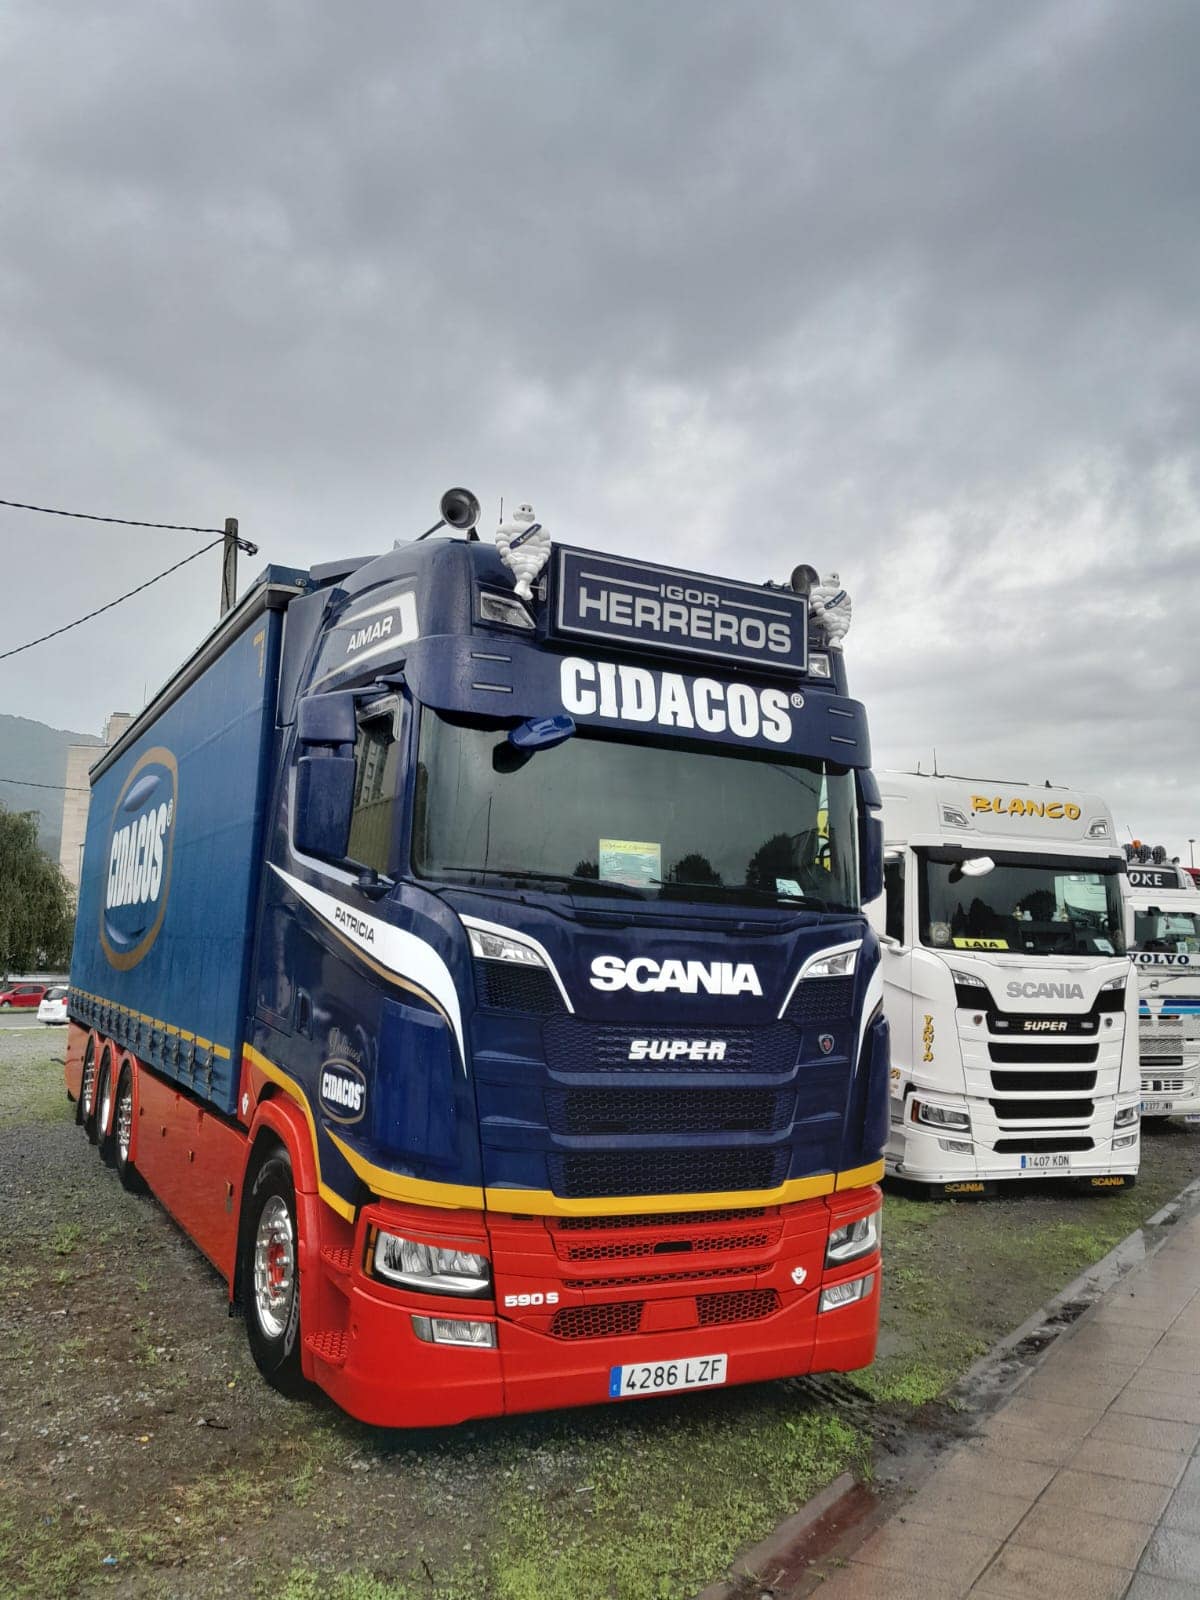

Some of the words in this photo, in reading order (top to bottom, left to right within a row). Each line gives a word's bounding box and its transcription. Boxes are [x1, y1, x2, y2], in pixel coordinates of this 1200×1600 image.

[660, 584, 720, 608] IGOR
[579, 587, 791, 653] HERREROS
[346, 616, 393, 653] AIMAR
[970, 795, 1081, 820] BLANCO
[335, 906, 374, 944] PATRICIA
[1127, 953, 1190, 965] VOLVO
[590, 957, 763, 996] SCANIA
[1006, 982, 1084, 999] SCANIA
[1023, 1020, 1067, 1031] SUPER
[628, 1040, 727, 1061] SUPER
[1028, 1156, 1050, 1167] 1407
[1053, 1155, 1070, 1166] KDN
[944, 1183, 985, 1192] SCANIA
[1091, 1177, 1125, 1186] SCANIA
[504, 1292, 542, 1307] 590
[545, 1292, 559, 1304] S
[626, 1364, 679, 1390] 4286
[685, 1358, 723, 1384] LZF
